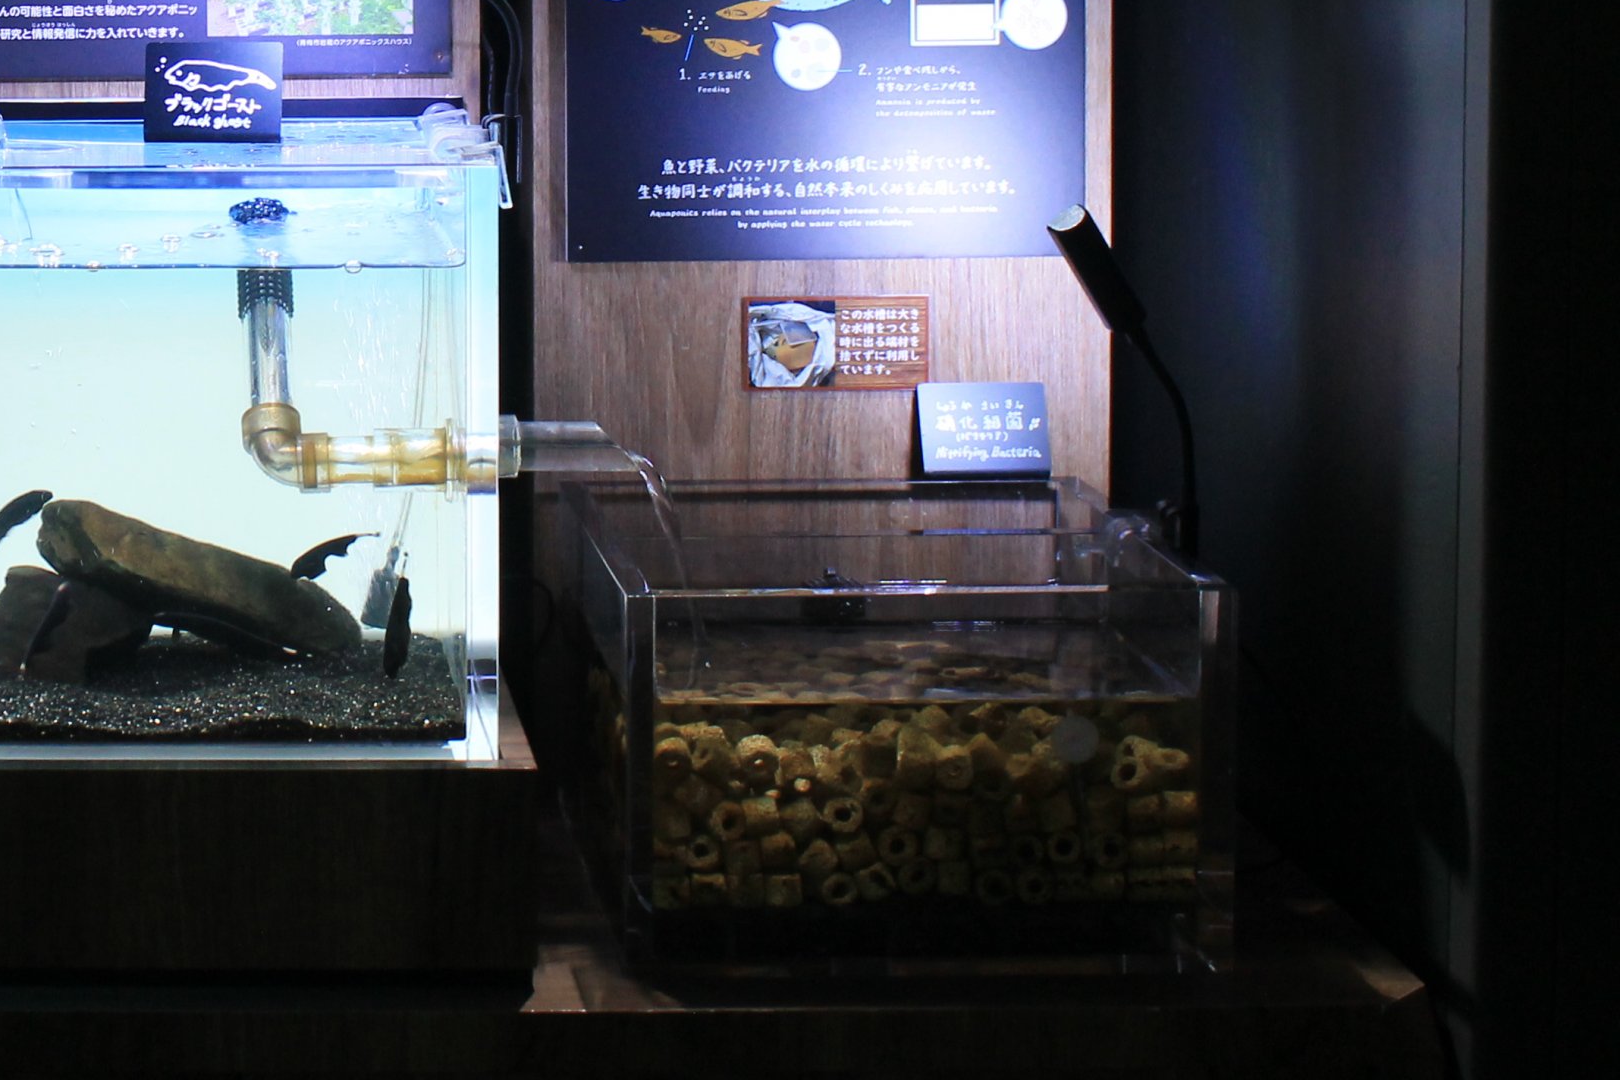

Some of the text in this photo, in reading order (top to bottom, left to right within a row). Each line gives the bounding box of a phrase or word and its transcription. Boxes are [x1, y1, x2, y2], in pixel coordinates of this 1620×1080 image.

[164, 93, 262, 115] ブラックゴースト
[173, 114, 252, 130] Black ghost
